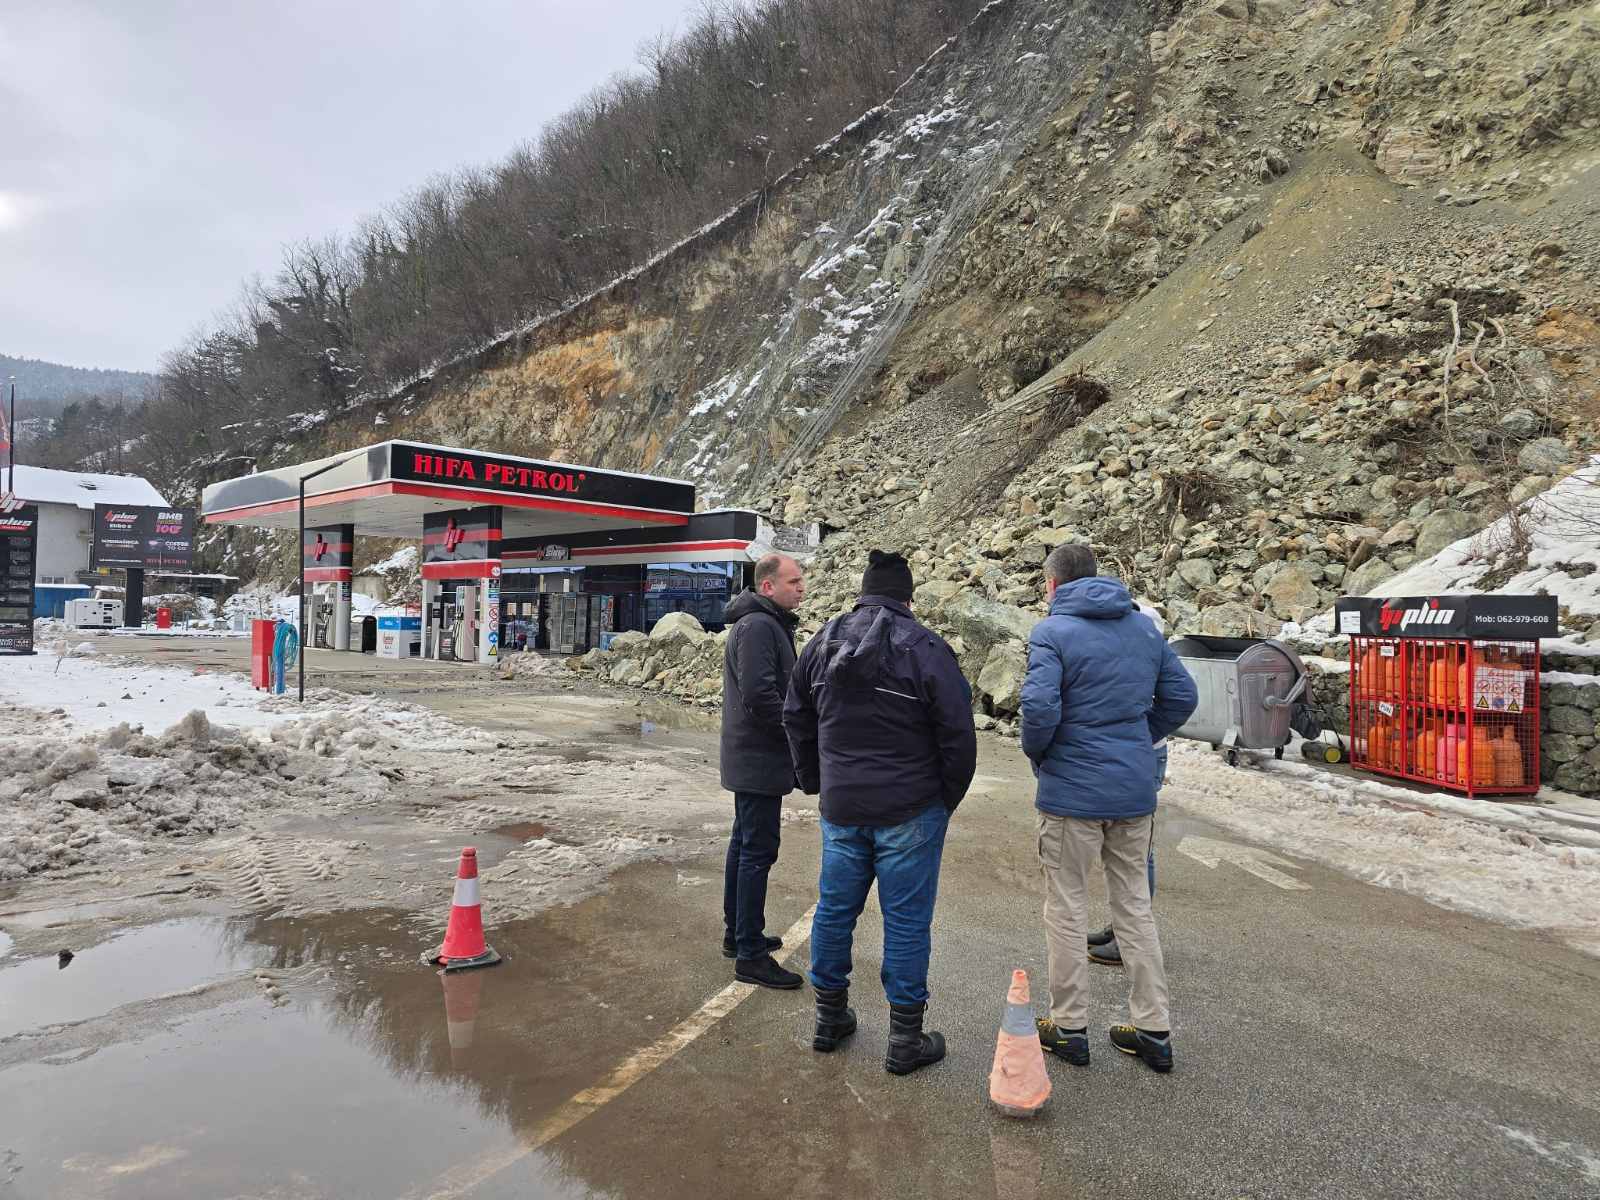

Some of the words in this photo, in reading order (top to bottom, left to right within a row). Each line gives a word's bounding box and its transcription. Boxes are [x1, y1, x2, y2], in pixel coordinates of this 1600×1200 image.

[413, 454, 476, 480] HIFA
[485, 463, 580, 493] PETROL
[1475, 615, 1495, 623] Mob:
[1497, 615, 1550, 624] 062-979-608
